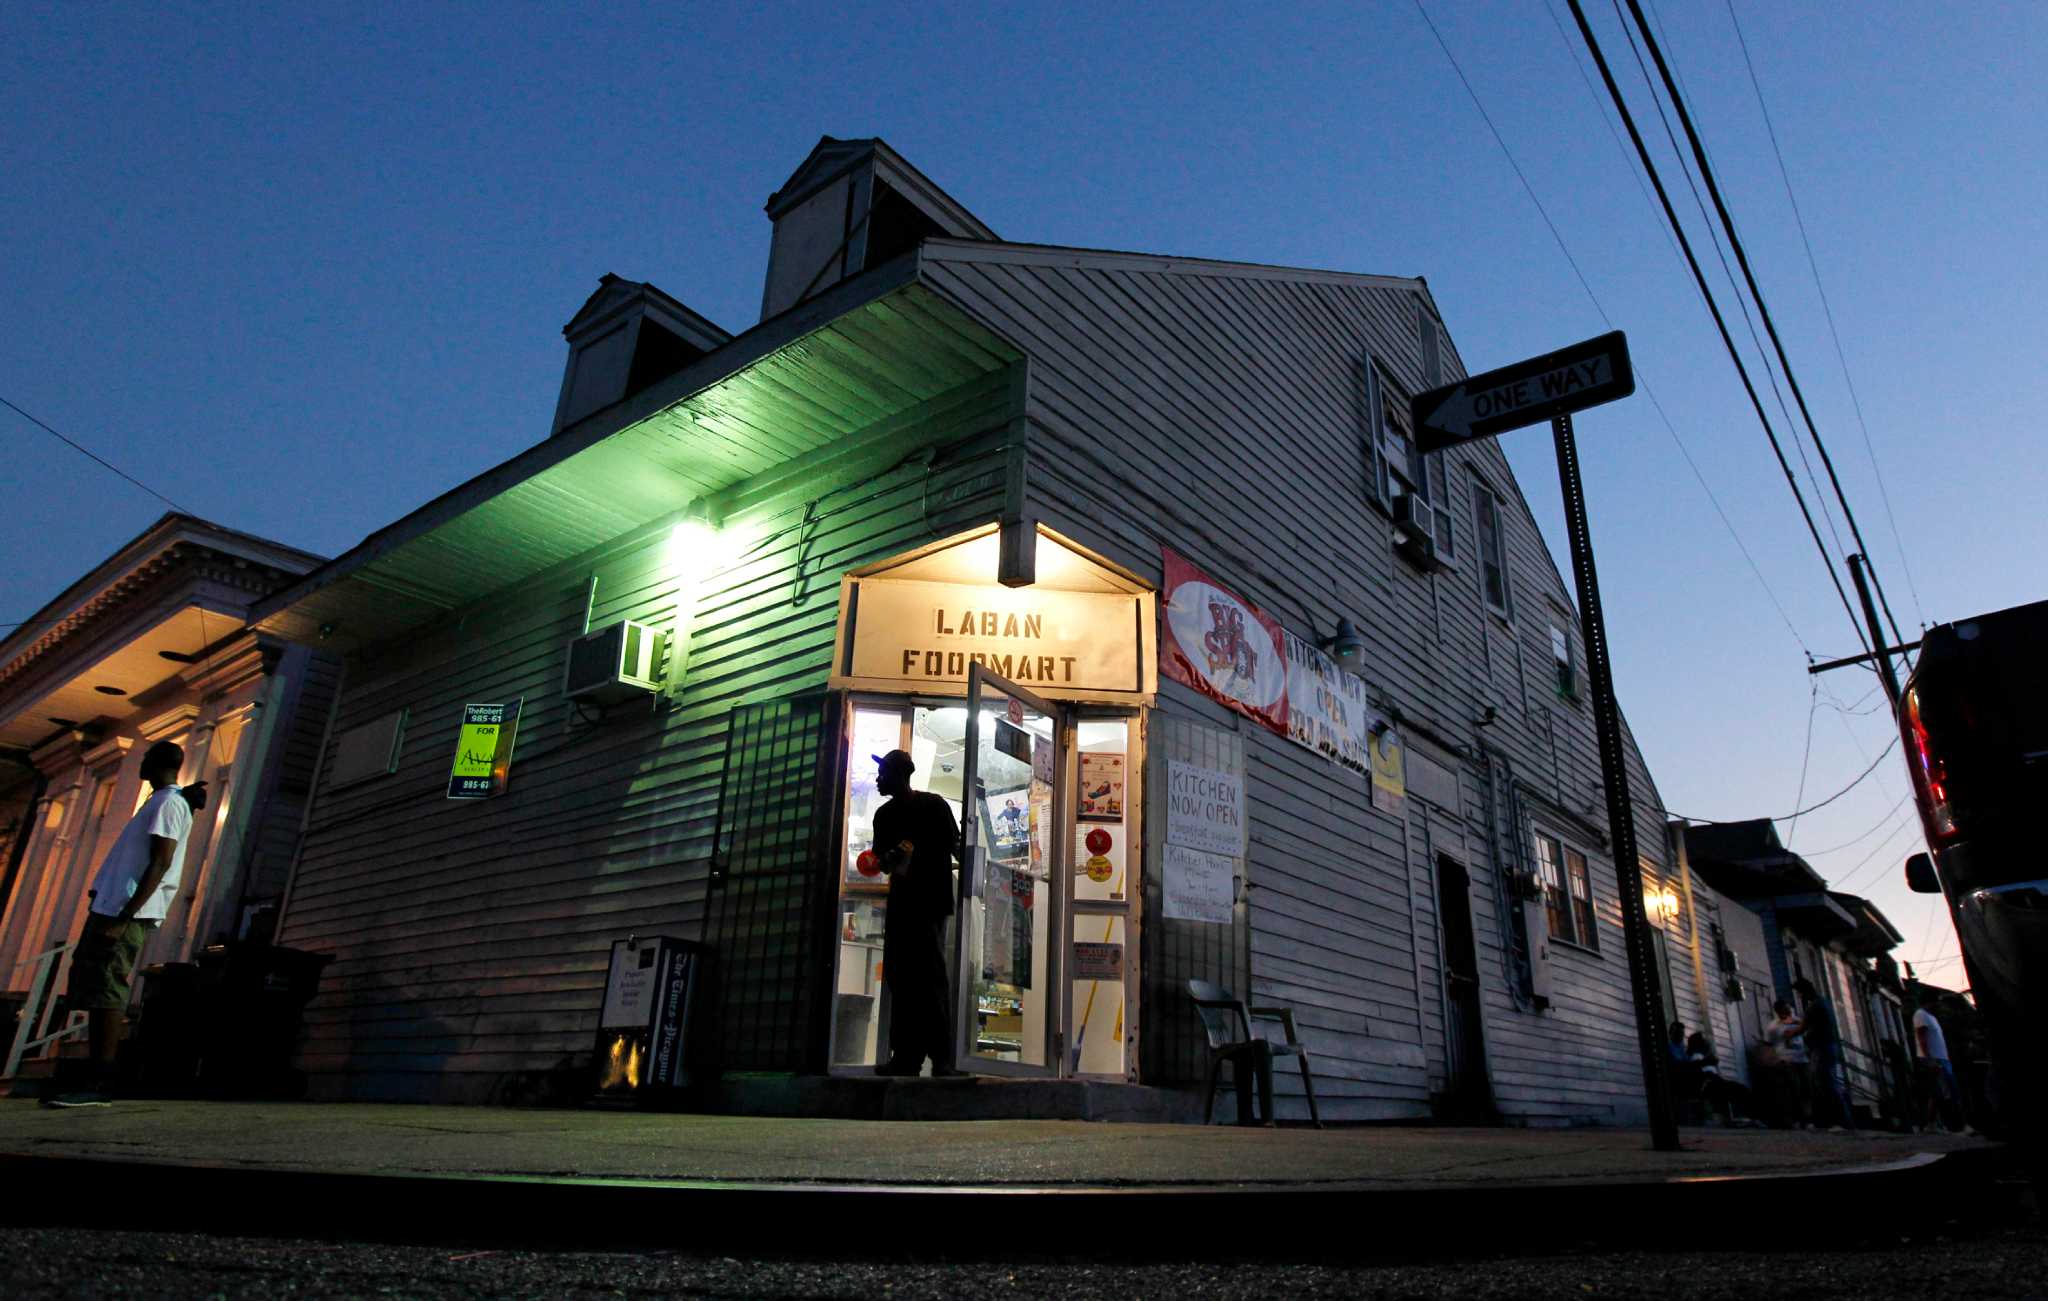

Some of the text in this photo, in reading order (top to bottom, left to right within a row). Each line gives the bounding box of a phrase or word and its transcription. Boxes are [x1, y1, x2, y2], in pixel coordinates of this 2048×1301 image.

[1474, 358, 1601, 418] ONE WAY
[937, 608, 1043, 639] LABAN
[476, 727, 495, 735] FOR
[1172, 769, 1236, 804] KITCHEN
[1170, 793, 1239, 827] NOW OPEN
